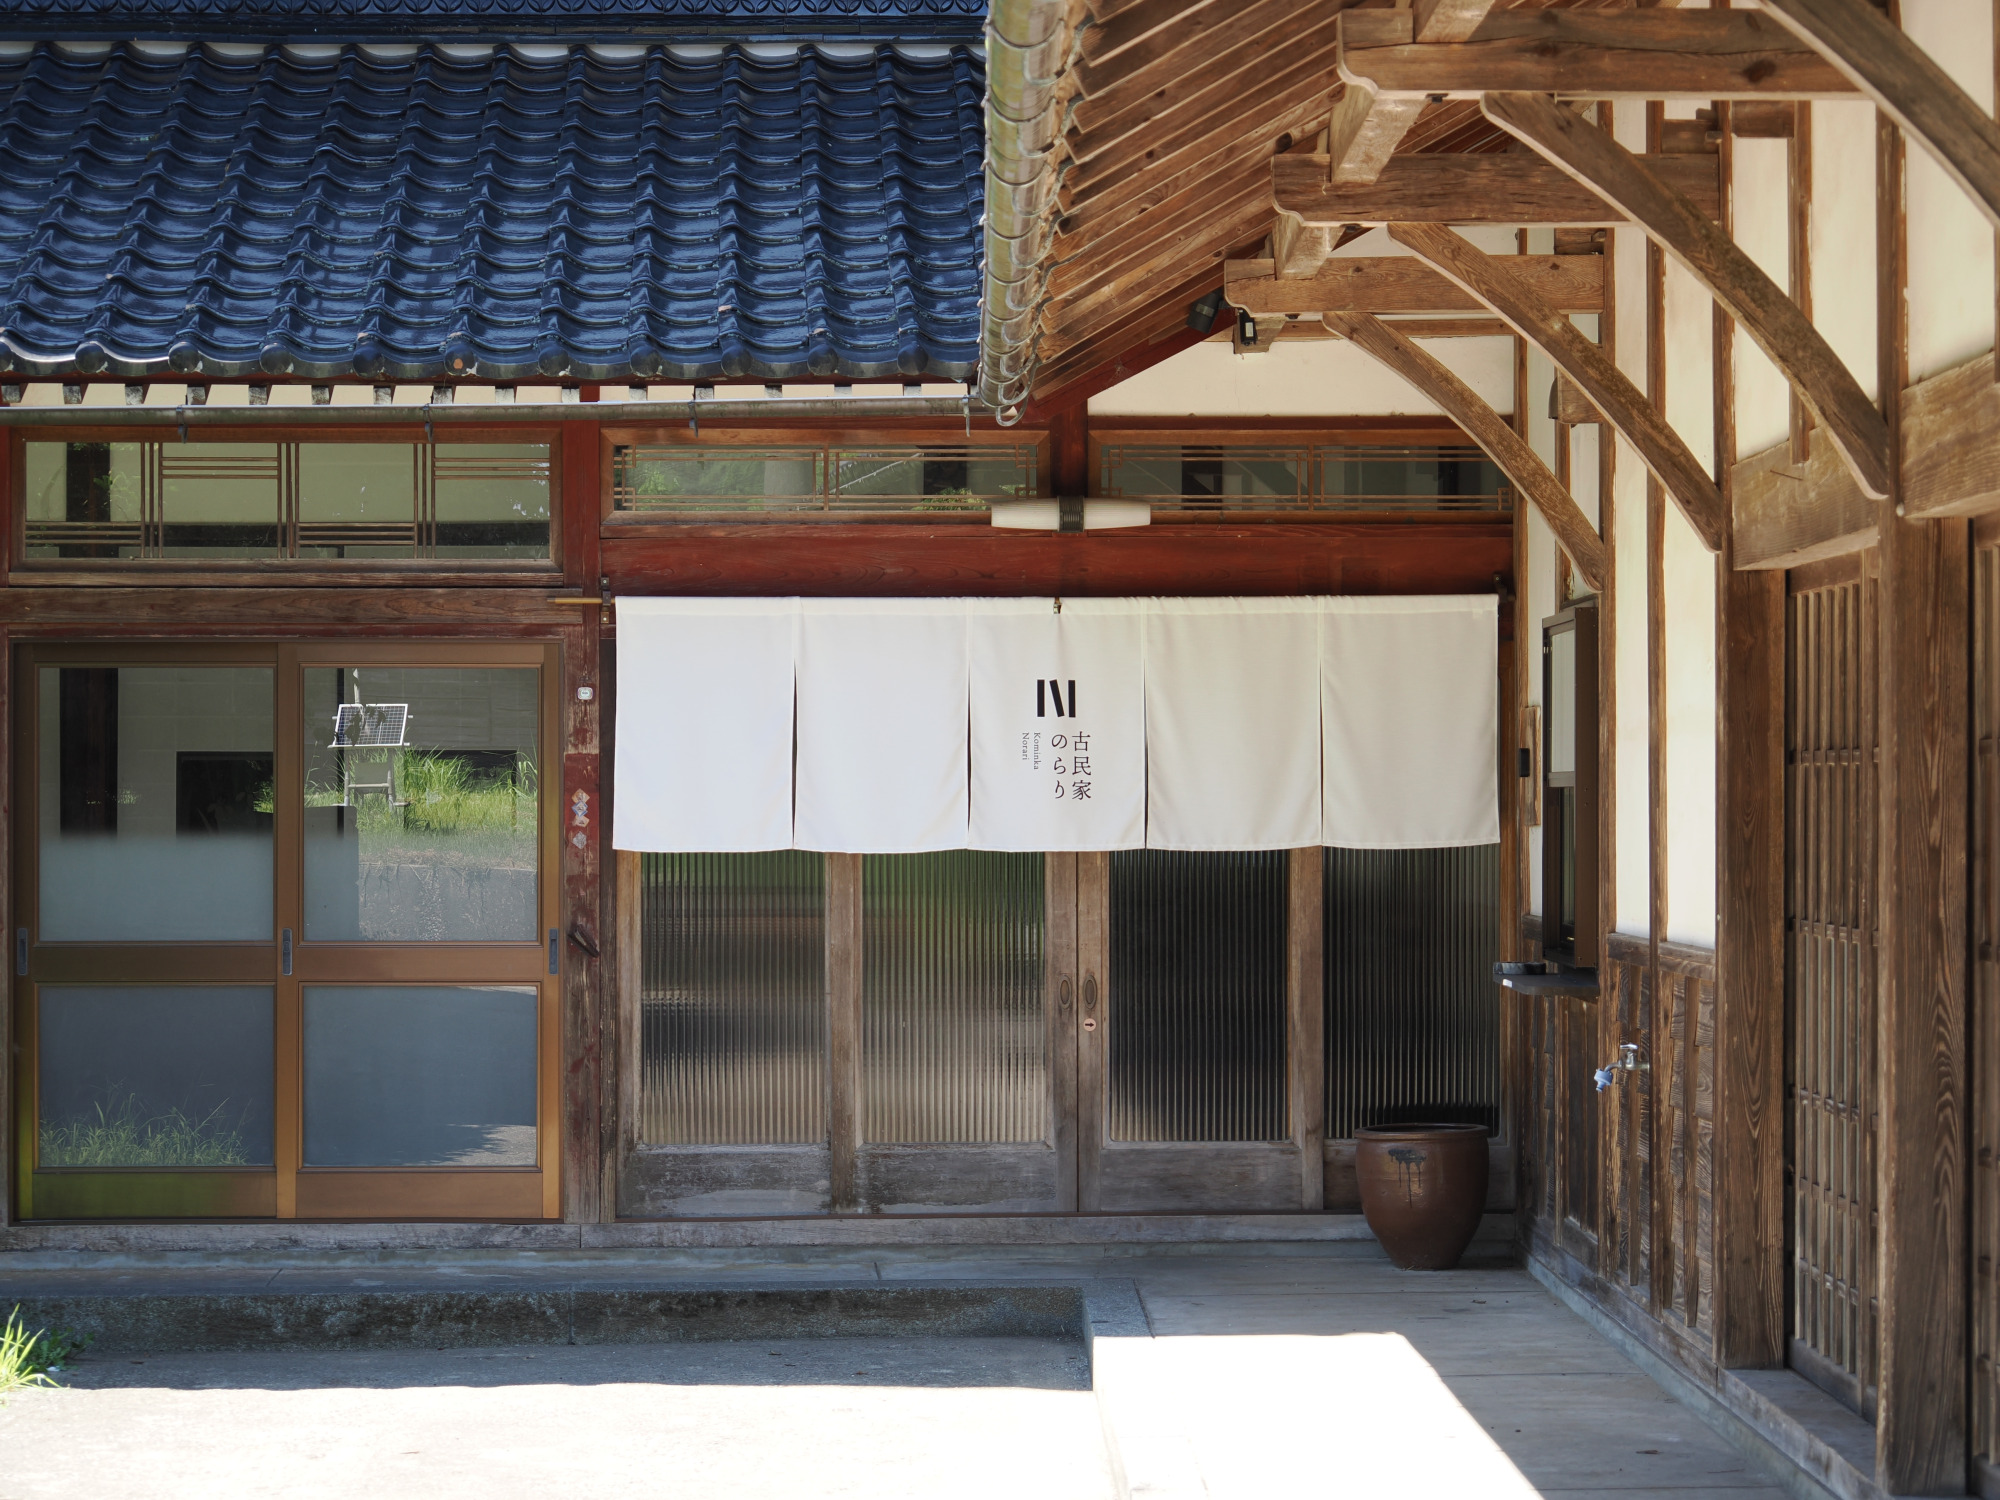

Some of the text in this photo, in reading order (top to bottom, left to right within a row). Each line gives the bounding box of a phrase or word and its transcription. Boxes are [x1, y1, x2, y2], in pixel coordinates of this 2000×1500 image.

[1022, 732, 1030, 761] Norari
[1033, 732, 1042, 770] Kominka
[1051, 734, 1068, 799] のらり
[1071, 731, 1092, 801] 古民家
